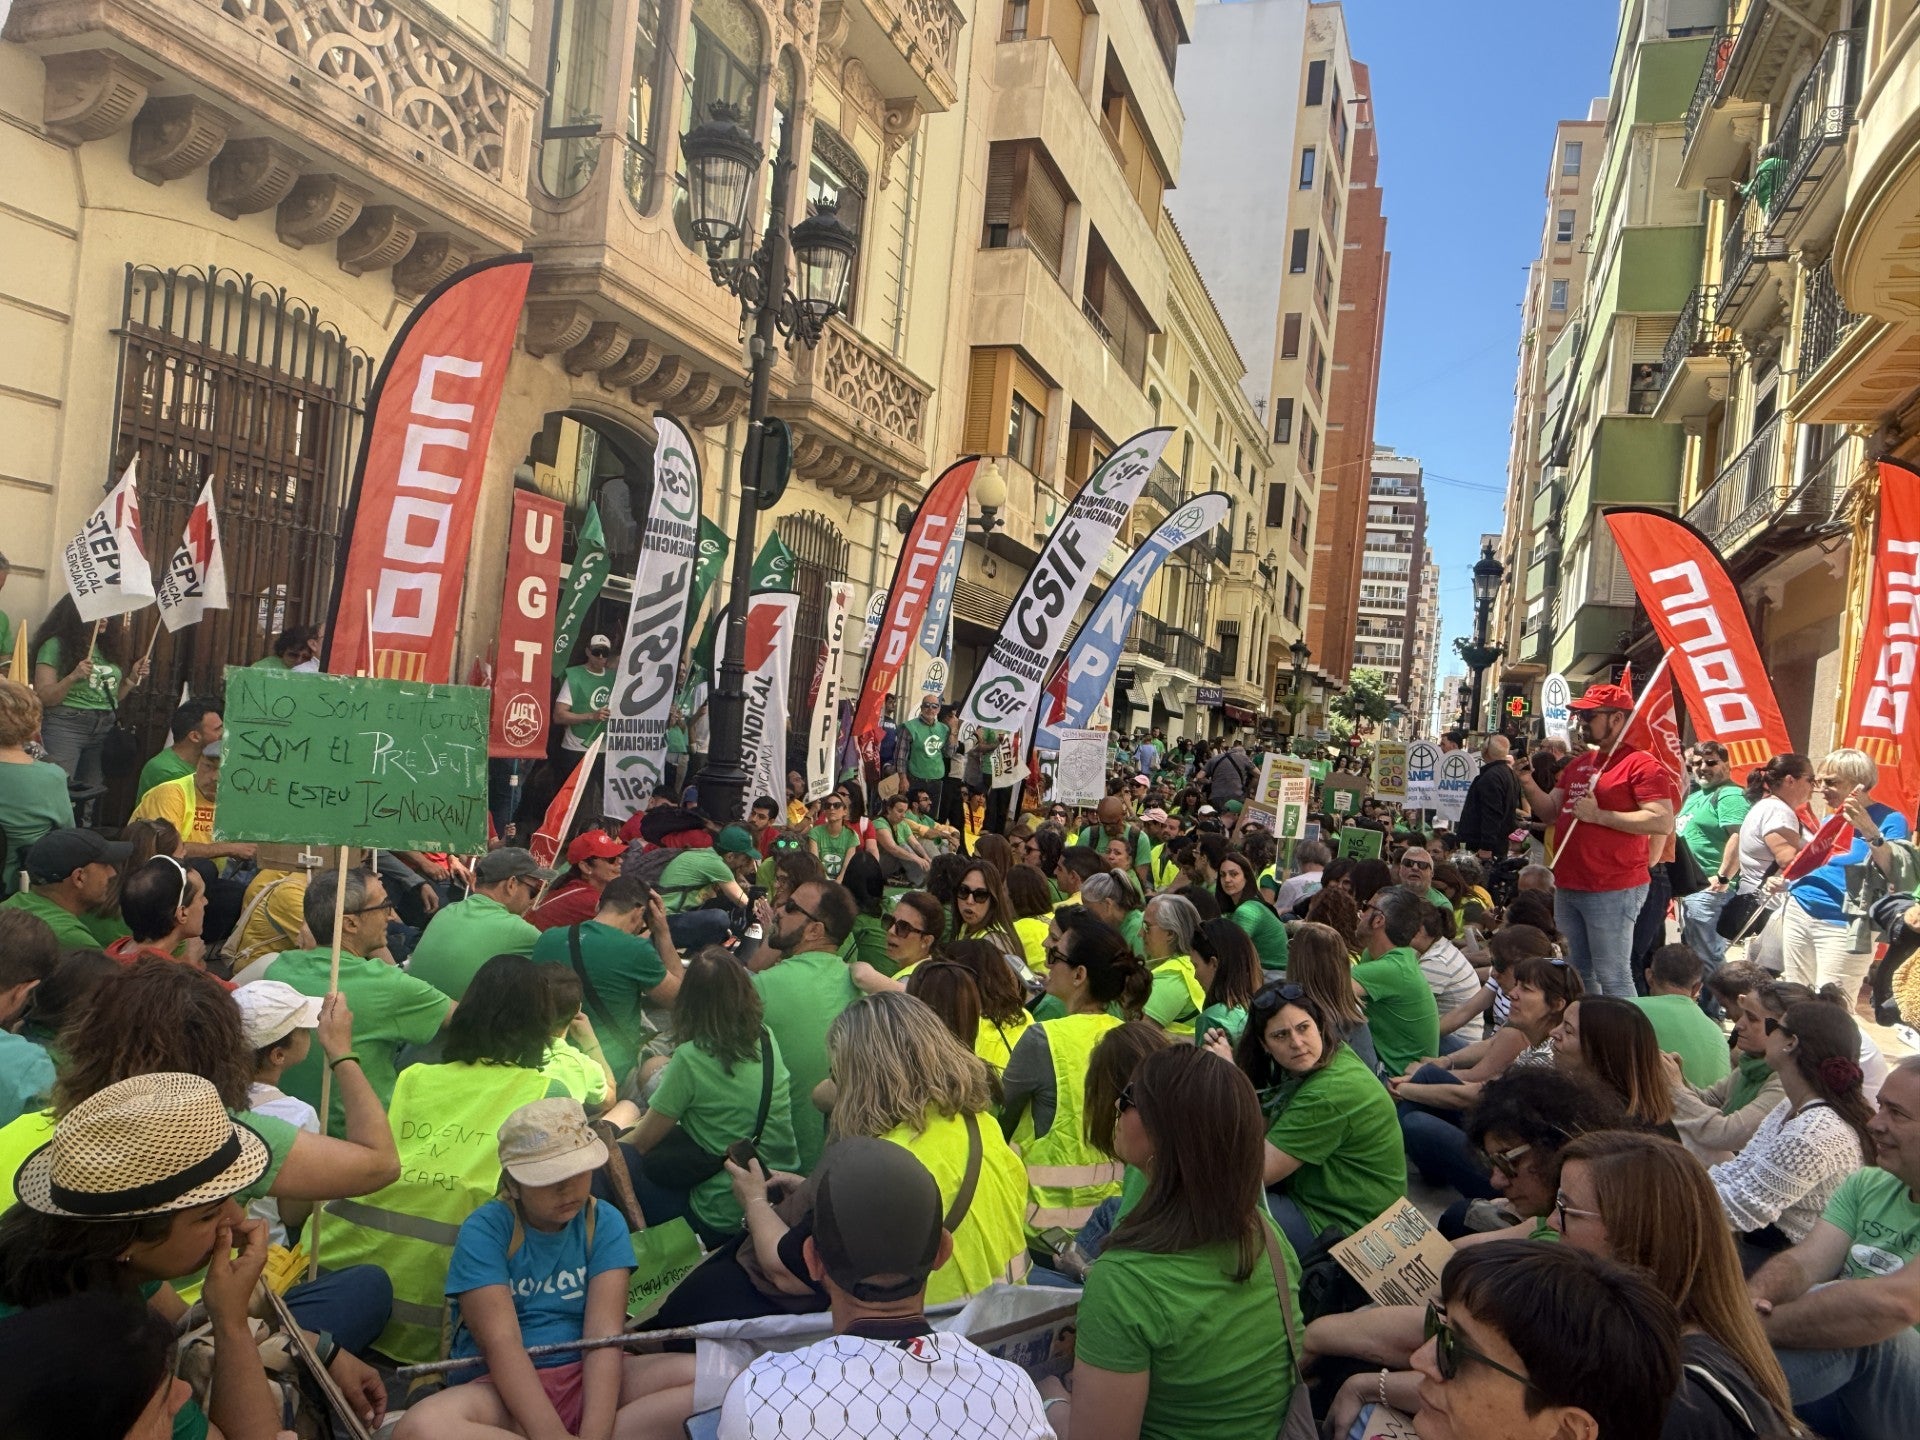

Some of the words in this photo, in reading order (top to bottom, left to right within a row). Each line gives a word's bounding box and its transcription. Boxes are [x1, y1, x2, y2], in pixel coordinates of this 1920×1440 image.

[372, 353, 483, 637] CCOO
[172, 545, 203, 598] EPV
[514, 509, 553, 683] UGT
[1017, 520, 1087, 651] CSIF
[242, 680, 297, 720] NO
[303, 692, 369, 721] SOM
[820, 613, 845, 776] STEPV
[984, 687, 1028, 715] CSIF
[240, 730, 311, 763] SOM
[331, 736, 354, 765] EL
[231, 768, 279, 796] QUE
[288, 781, 350, 808] ESTEU
[354, 780, 484, 835] IGNORANT
